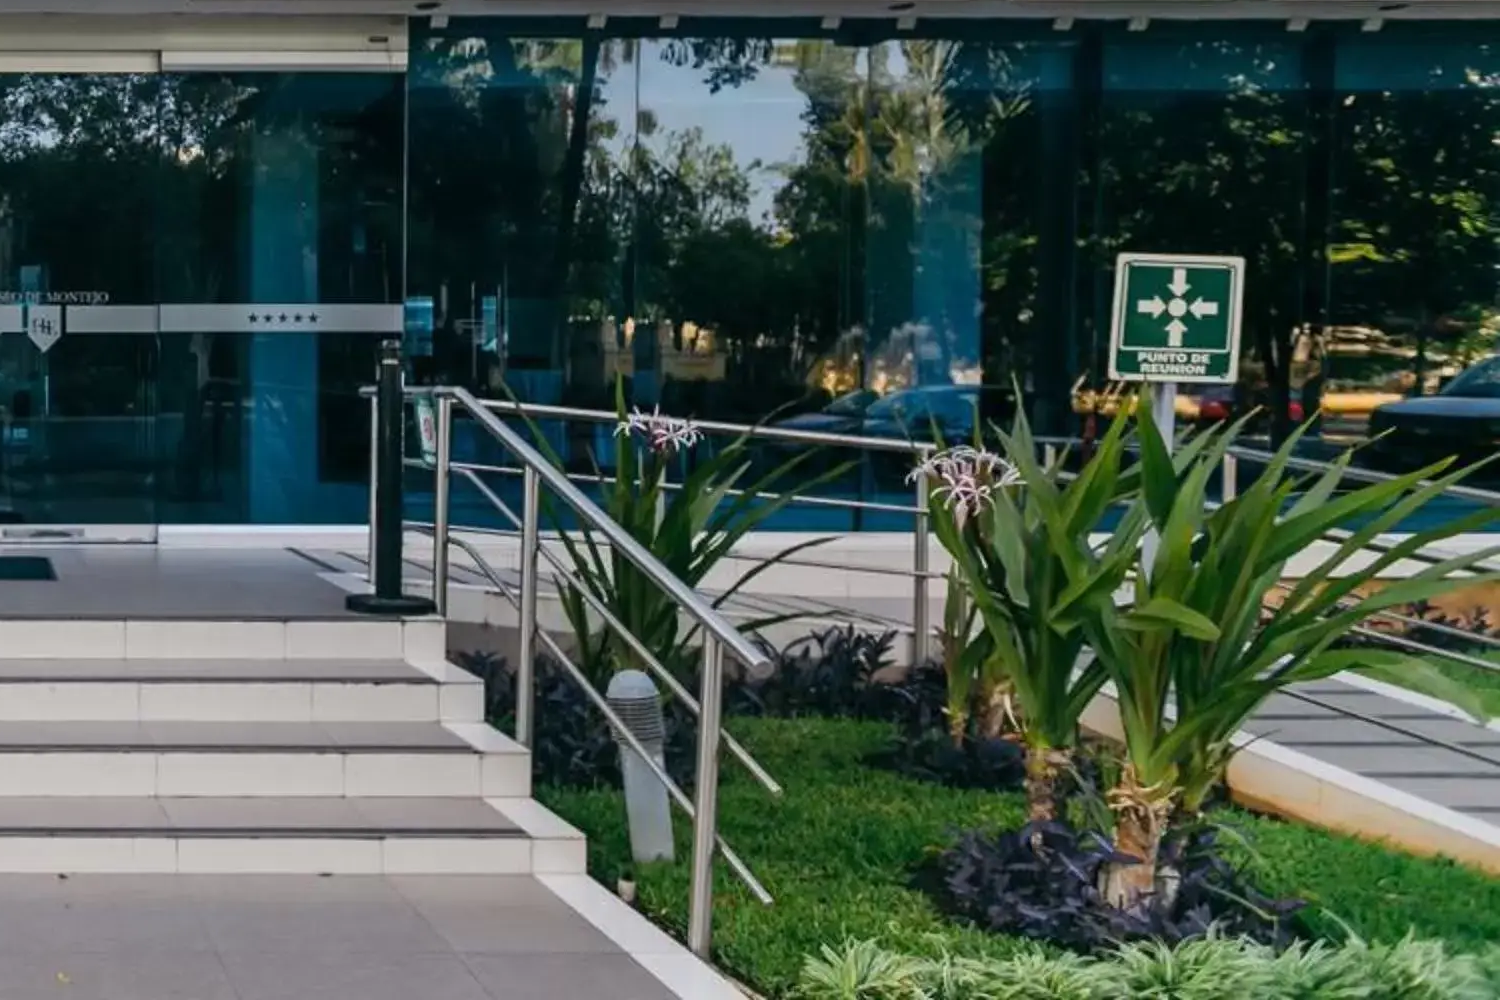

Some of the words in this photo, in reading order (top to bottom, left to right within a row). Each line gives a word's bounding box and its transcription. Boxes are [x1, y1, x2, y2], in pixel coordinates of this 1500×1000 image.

[46, 290, 110, 303] MONTEJO
[1137, 351, 1187, 363] PUNTO
[1191, 353, 1211, 364] DE
[1140, 362, 1207, 375] REUNION
